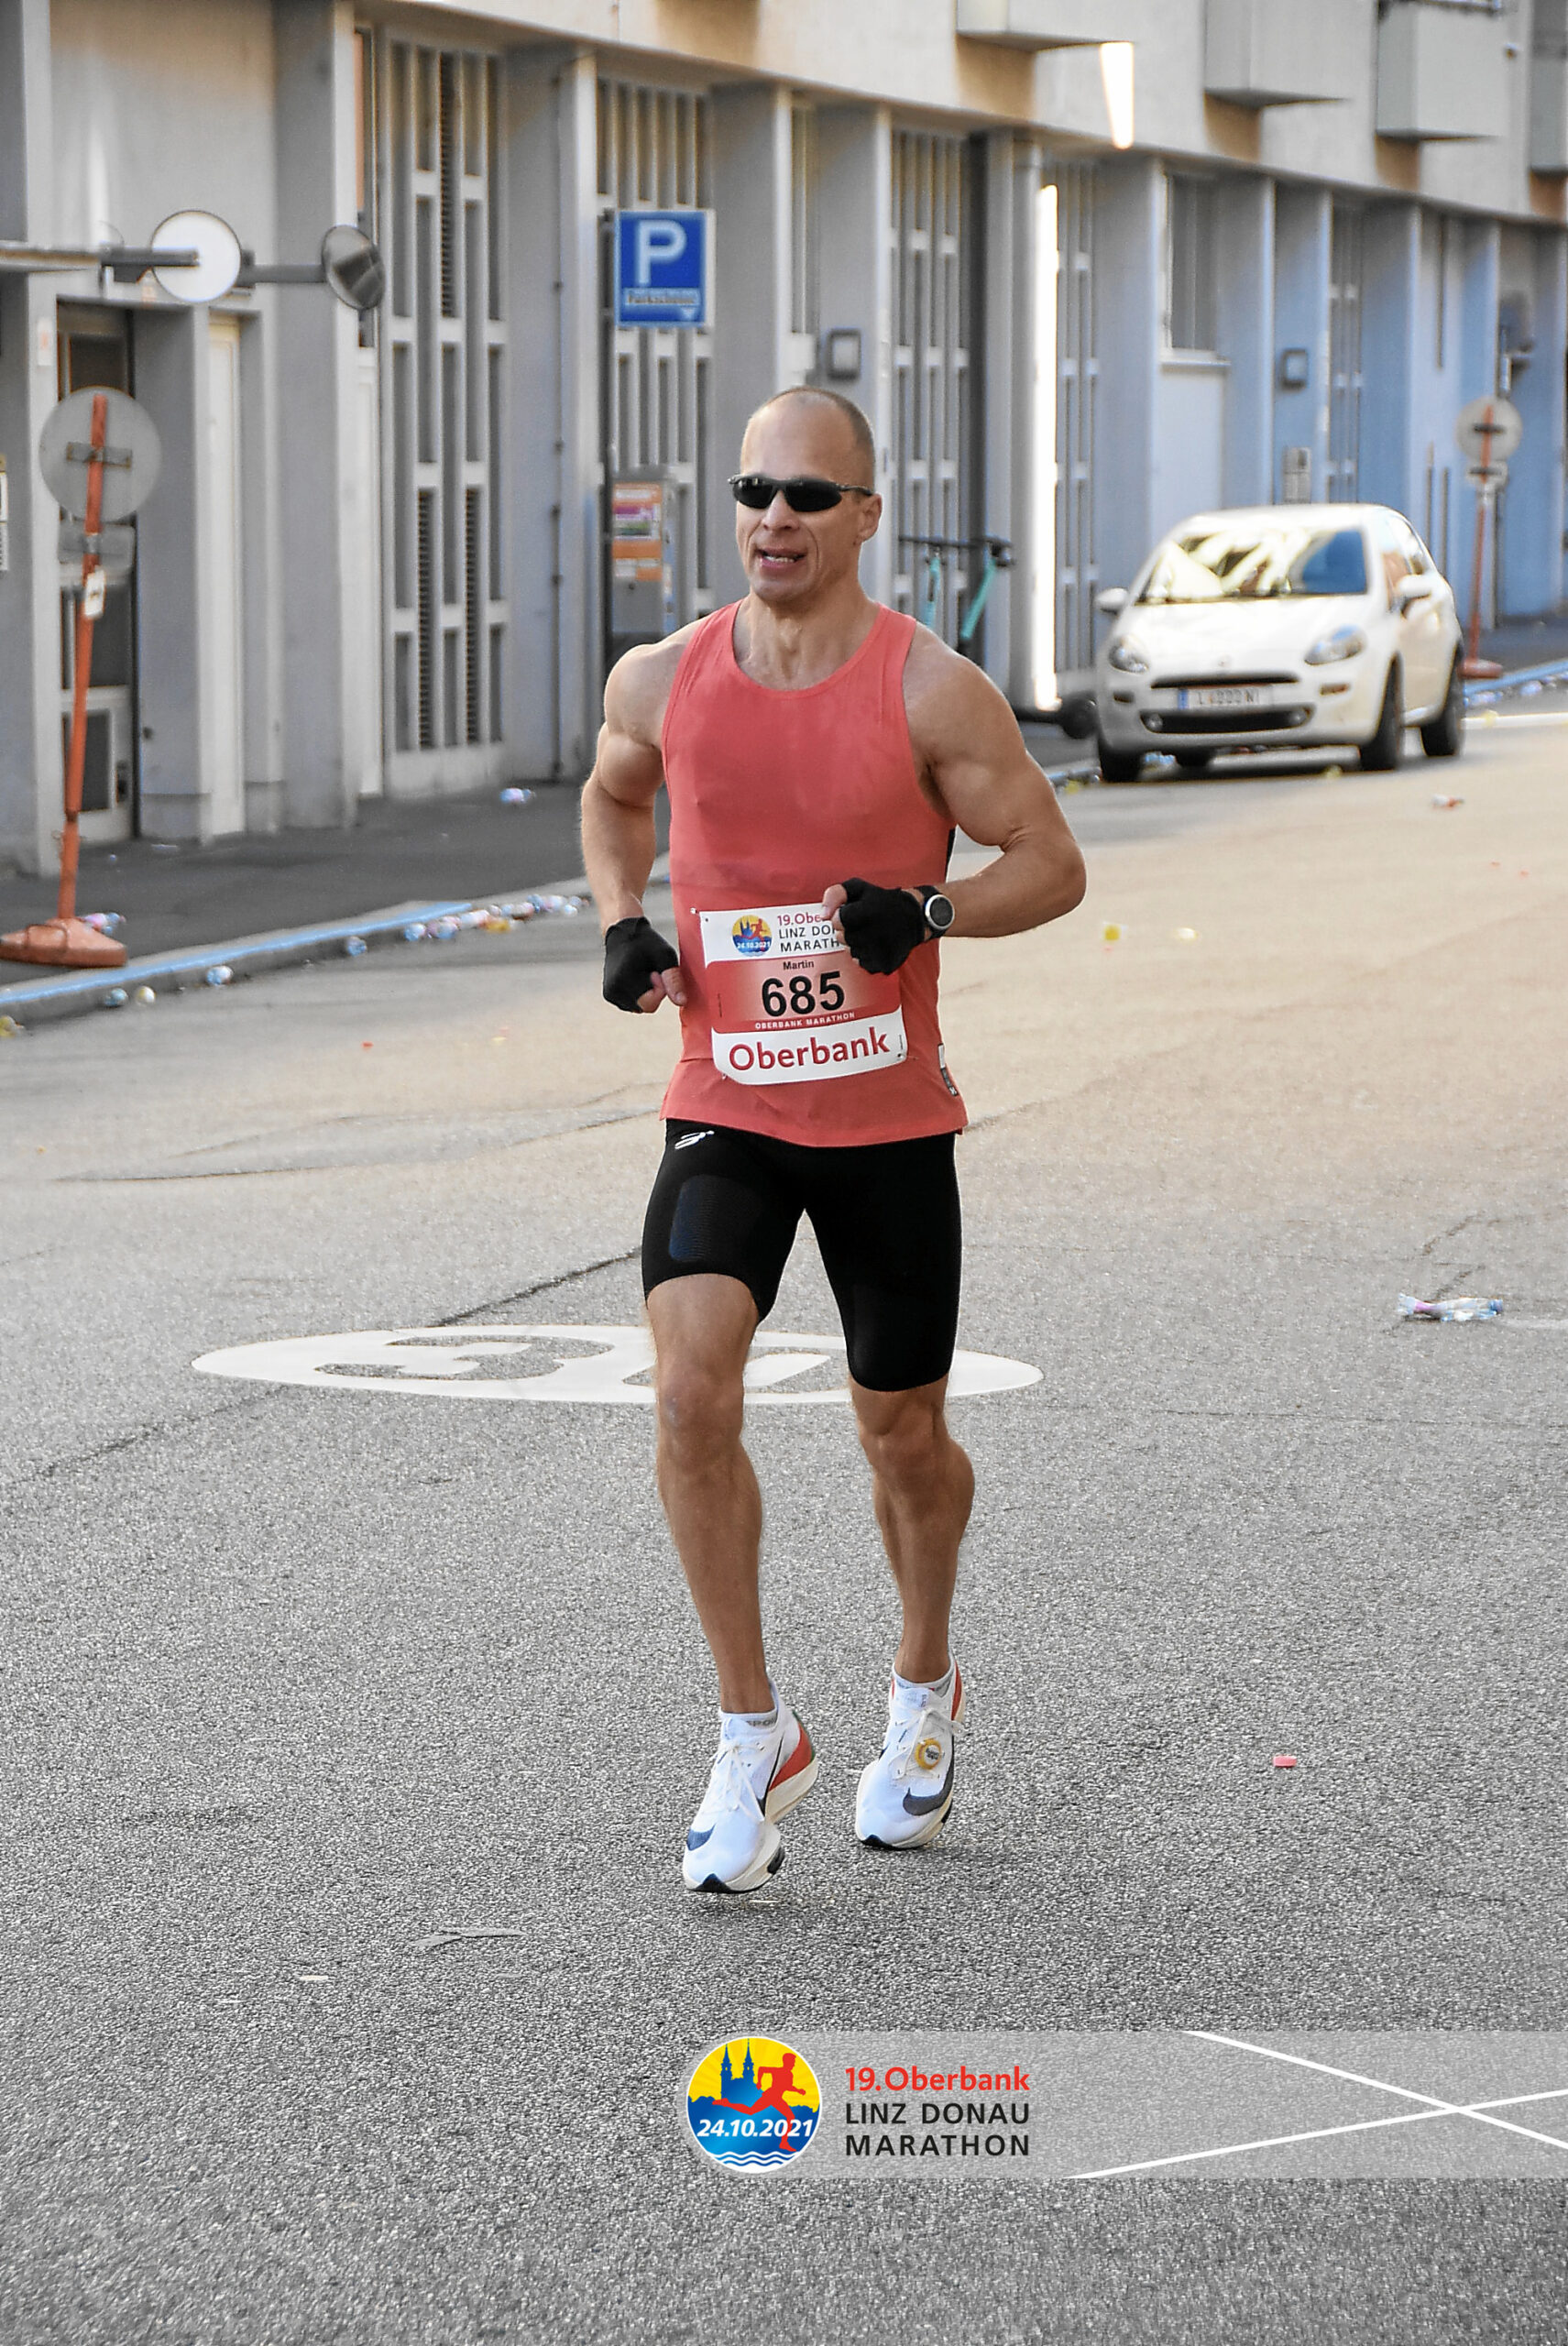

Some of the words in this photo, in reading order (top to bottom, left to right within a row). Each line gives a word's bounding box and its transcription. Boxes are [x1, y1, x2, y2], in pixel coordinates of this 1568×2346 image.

[638, 220, 687, 284] P
[777, 912, 823, 926] 19.Obe
[779, 926, 806, 939] LINZ
[780, 937, 840, 953] MARATH
[783, 959, 815, 970] Martin
[762, 970, 845, 1017] 685
[755, 1019, 803, 1030] OBERBANK
[806, 1012, 855, 1025] MARATHON
[729, 1027, 890, 1071] Oberbank
